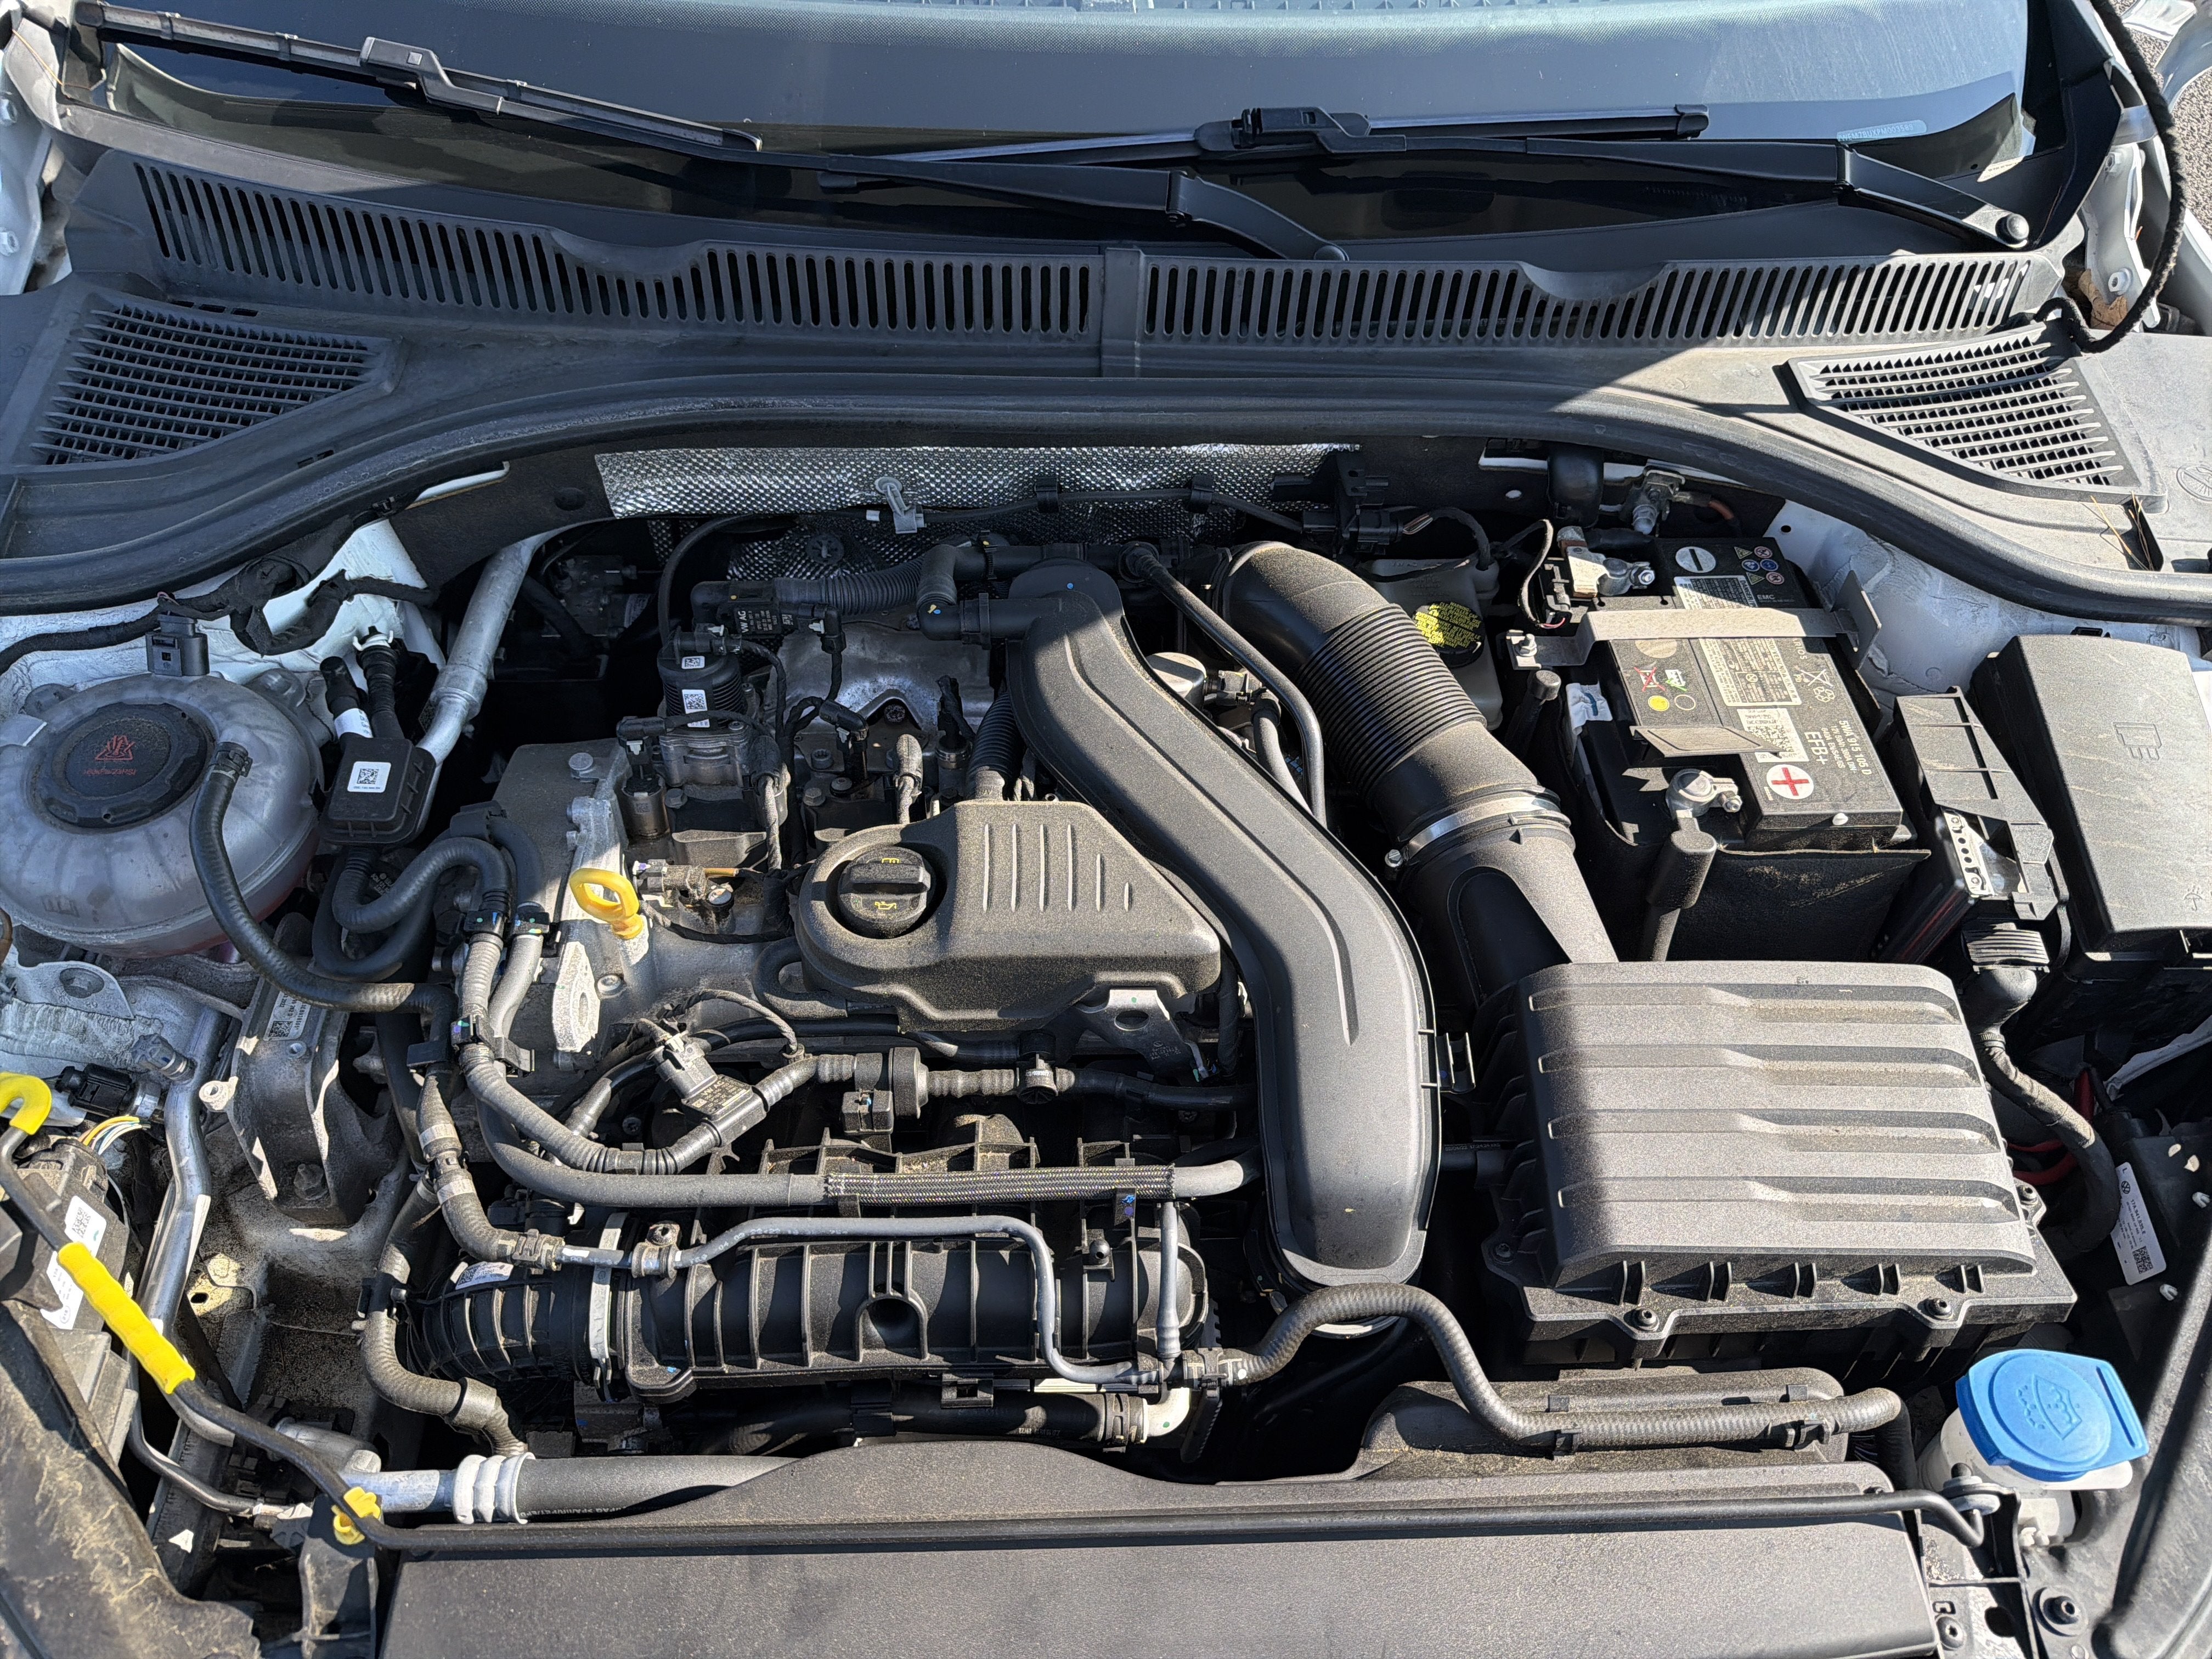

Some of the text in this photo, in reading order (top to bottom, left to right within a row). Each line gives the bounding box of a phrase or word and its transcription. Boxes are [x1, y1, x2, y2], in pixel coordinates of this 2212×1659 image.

[738, 611, 749, 633] VW AG
[1793, 674, 1802, 682] Pb
[1804, 732, 1829, 765] EFB+
[1839, 720, 1854, 736] 5WA
[1847, 738, 1861, 752] 915
[1855, 754, 1869, 768] 105
[701, 1087, 714, 1096] VW
